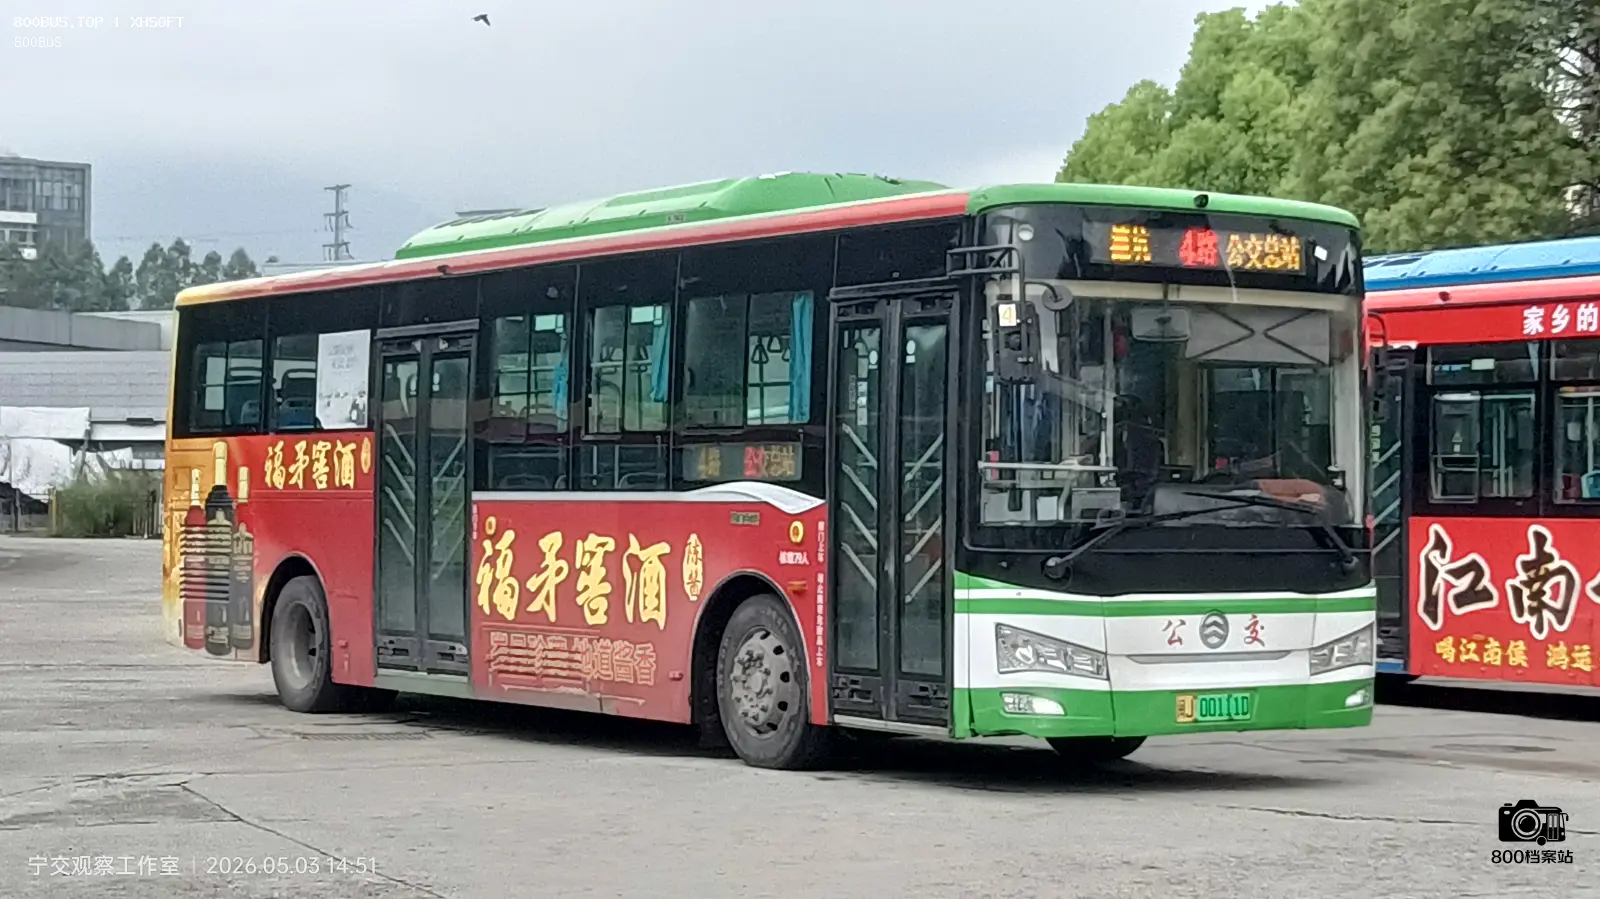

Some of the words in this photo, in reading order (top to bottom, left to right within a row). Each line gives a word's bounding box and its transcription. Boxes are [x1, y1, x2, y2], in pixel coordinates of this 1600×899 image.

[1226, 233, 1300, 270] 公交总站
[1002, 306, 1012, 324] 4
[1523, 303, 1599, 335] 家乡的
[1417, 523, 1600, 640] 江南
[1162, 619, 1187, 646] 公
[1243, 614, 1266, 647] 交
